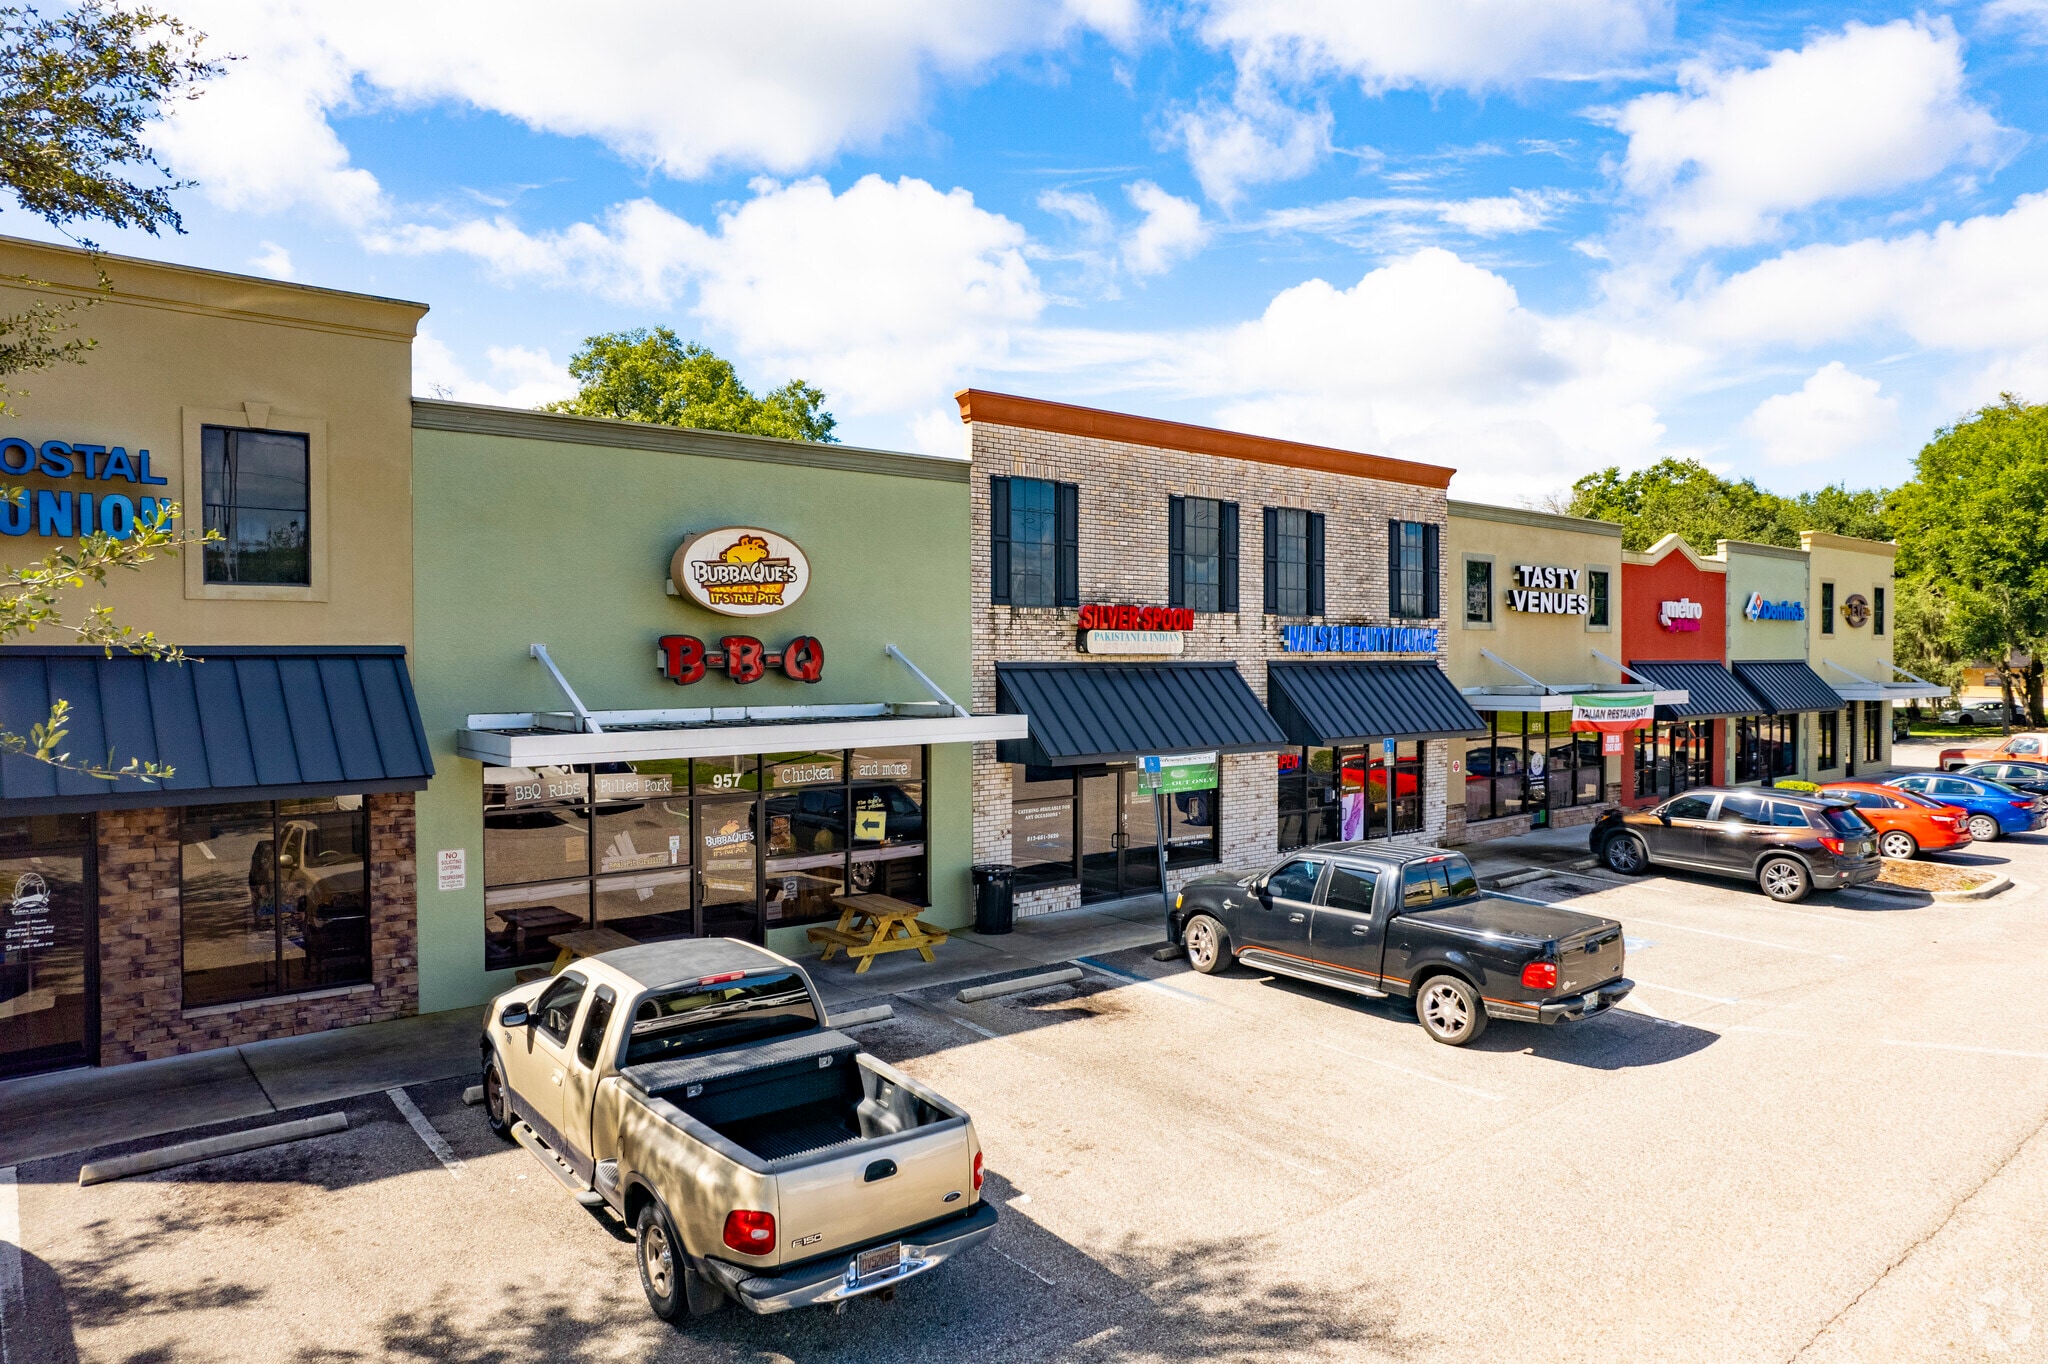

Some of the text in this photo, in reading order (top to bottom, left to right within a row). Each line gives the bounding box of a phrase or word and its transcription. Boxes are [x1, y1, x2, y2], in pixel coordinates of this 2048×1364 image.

[0, 437, 168, 485] OSTAL
[0, 486, 173, 541] UNION
[691, 560, 798, 584] BUBBAQUE'S
[1516, 565, 1581, 589] TASTY
[710, 592, 730, 605] IT'S
[733, 592, 754, 604] THE
[1510, 590, 1589, 615] VENUES
[1660, 597, 1703, 620] metro
[1078, 604, 1195, 631] SILVER SPOON
[1763, 599, 1805, 621] Domino's
[1094, 631, 1180, 642] PAKISTANI & INDIAN
[1285, 626, 1438, 653] NAILS & BEAUTY LOUNGE
[658, 634, 825, 686] B-B-Q
[1531, 722, 1542, 731] 951
[781, 764, 835, 784] Chicken
[859, 761, 908, 776] and more
[514, 780, 581, 801] BBQ Ribs
[600, 778, 670, 793] Pulled Pork
[712, 773, 742, 789] 957
[704, 831, 755, 847] BUBBAQUE'S
[445, 851, 458, 859] NO
